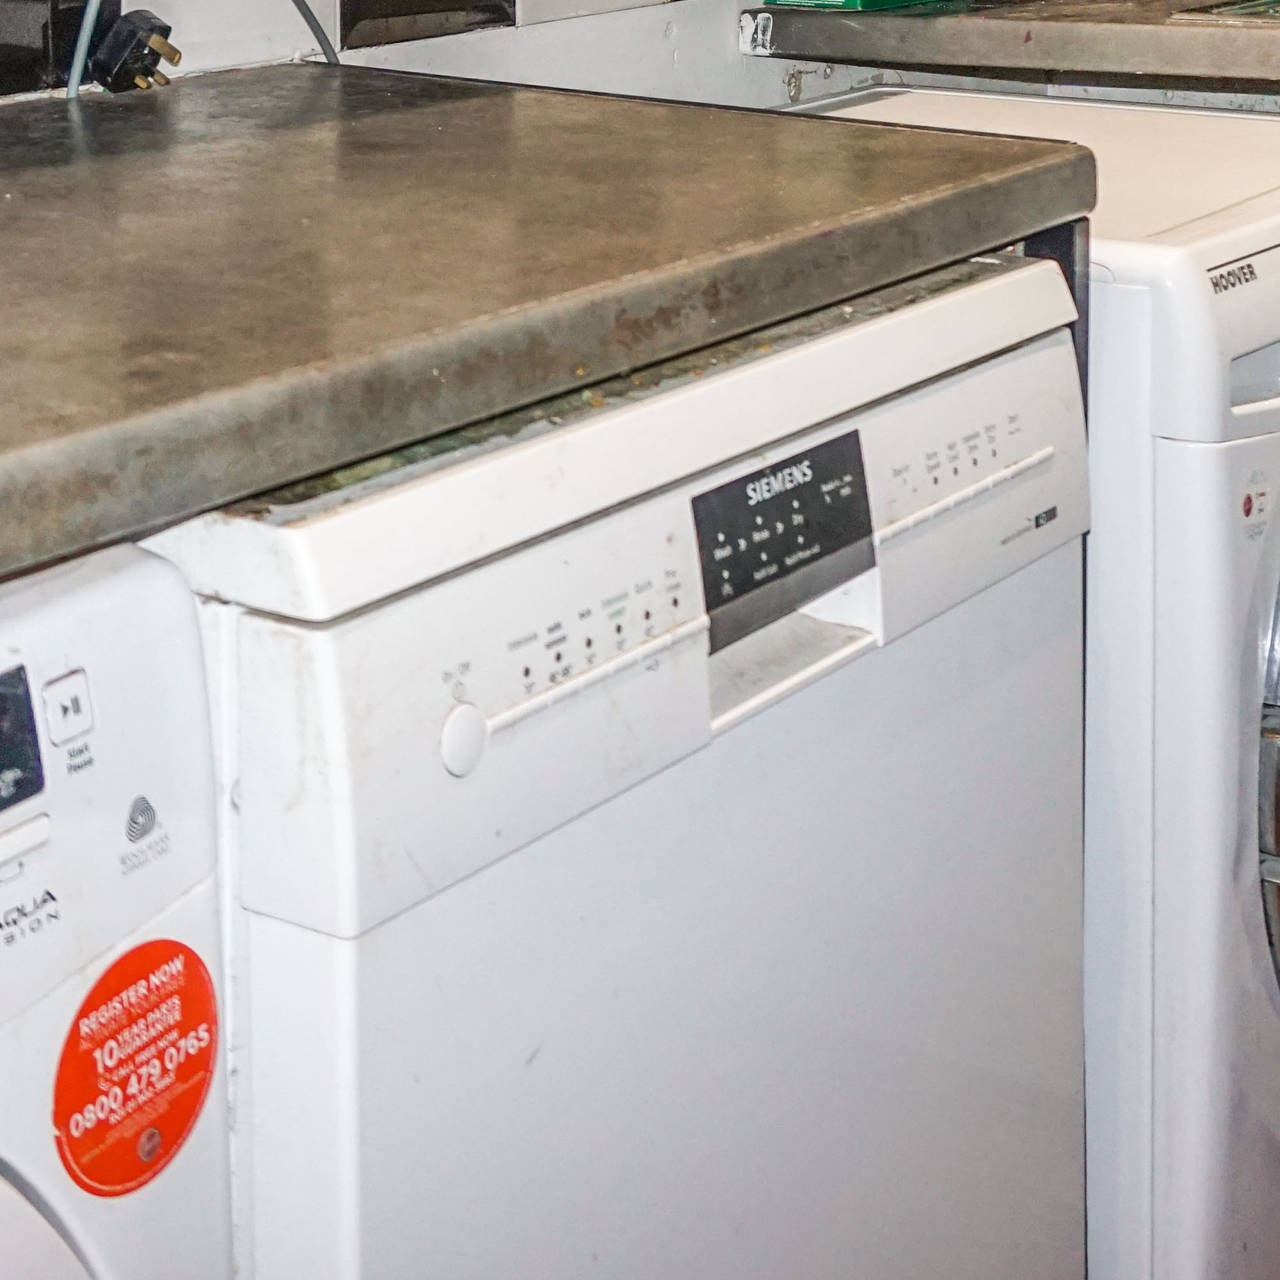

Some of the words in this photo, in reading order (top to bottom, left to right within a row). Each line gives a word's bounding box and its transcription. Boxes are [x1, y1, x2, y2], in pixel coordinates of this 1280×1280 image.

[1209, 263, 1258, 295] HOOVER
[746, 460, 813, 506] SIEMENS
[79, 979, 149, 1037] REGISTER
[149, 953, 184, 989] NOW
[116, 1018, 147, 1042] YEAR
[147, 994, 181, 1025] PARTS
[92, 1038, 120, 1073] 10
[135, 1043, 158, 1067] FREE
[157, 1027, 180, 1050] NOW
[69, 1086, 124, 1139] 0800
[126, 1058, 163, 1096] 479
[164, 1023, 210, 1070] 0765
